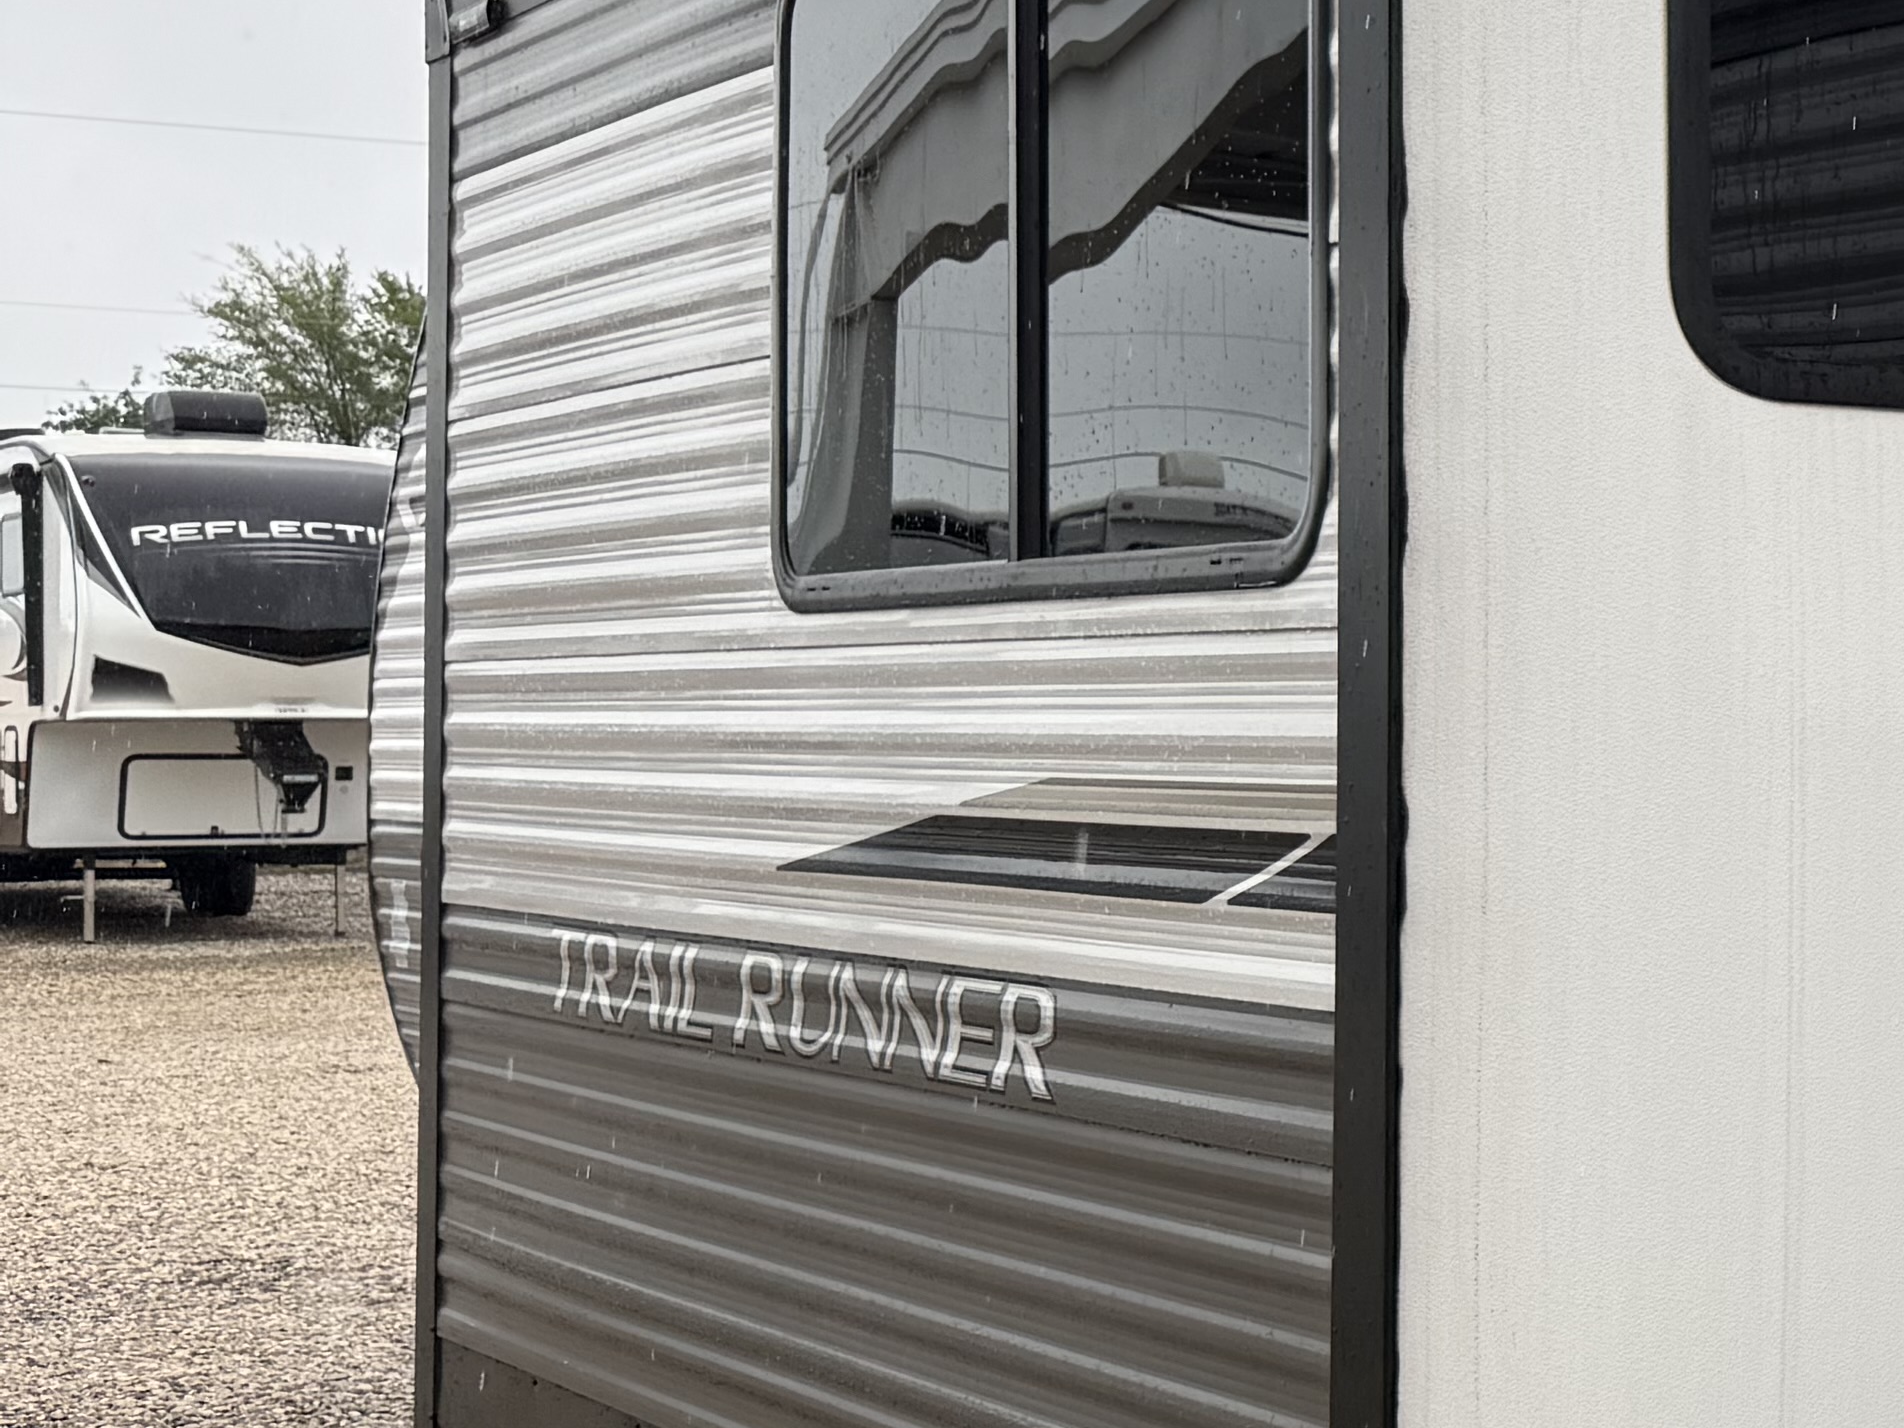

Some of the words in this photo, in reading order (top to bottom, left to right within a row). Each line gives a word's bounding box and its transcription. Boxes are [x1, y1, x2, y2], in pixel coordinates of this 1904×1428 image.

[131, 520, 385, 547] REFLECTI
[551, 928, 714, 1041] TRAIL
[732, 949, 1058, 1103] RUNNER
